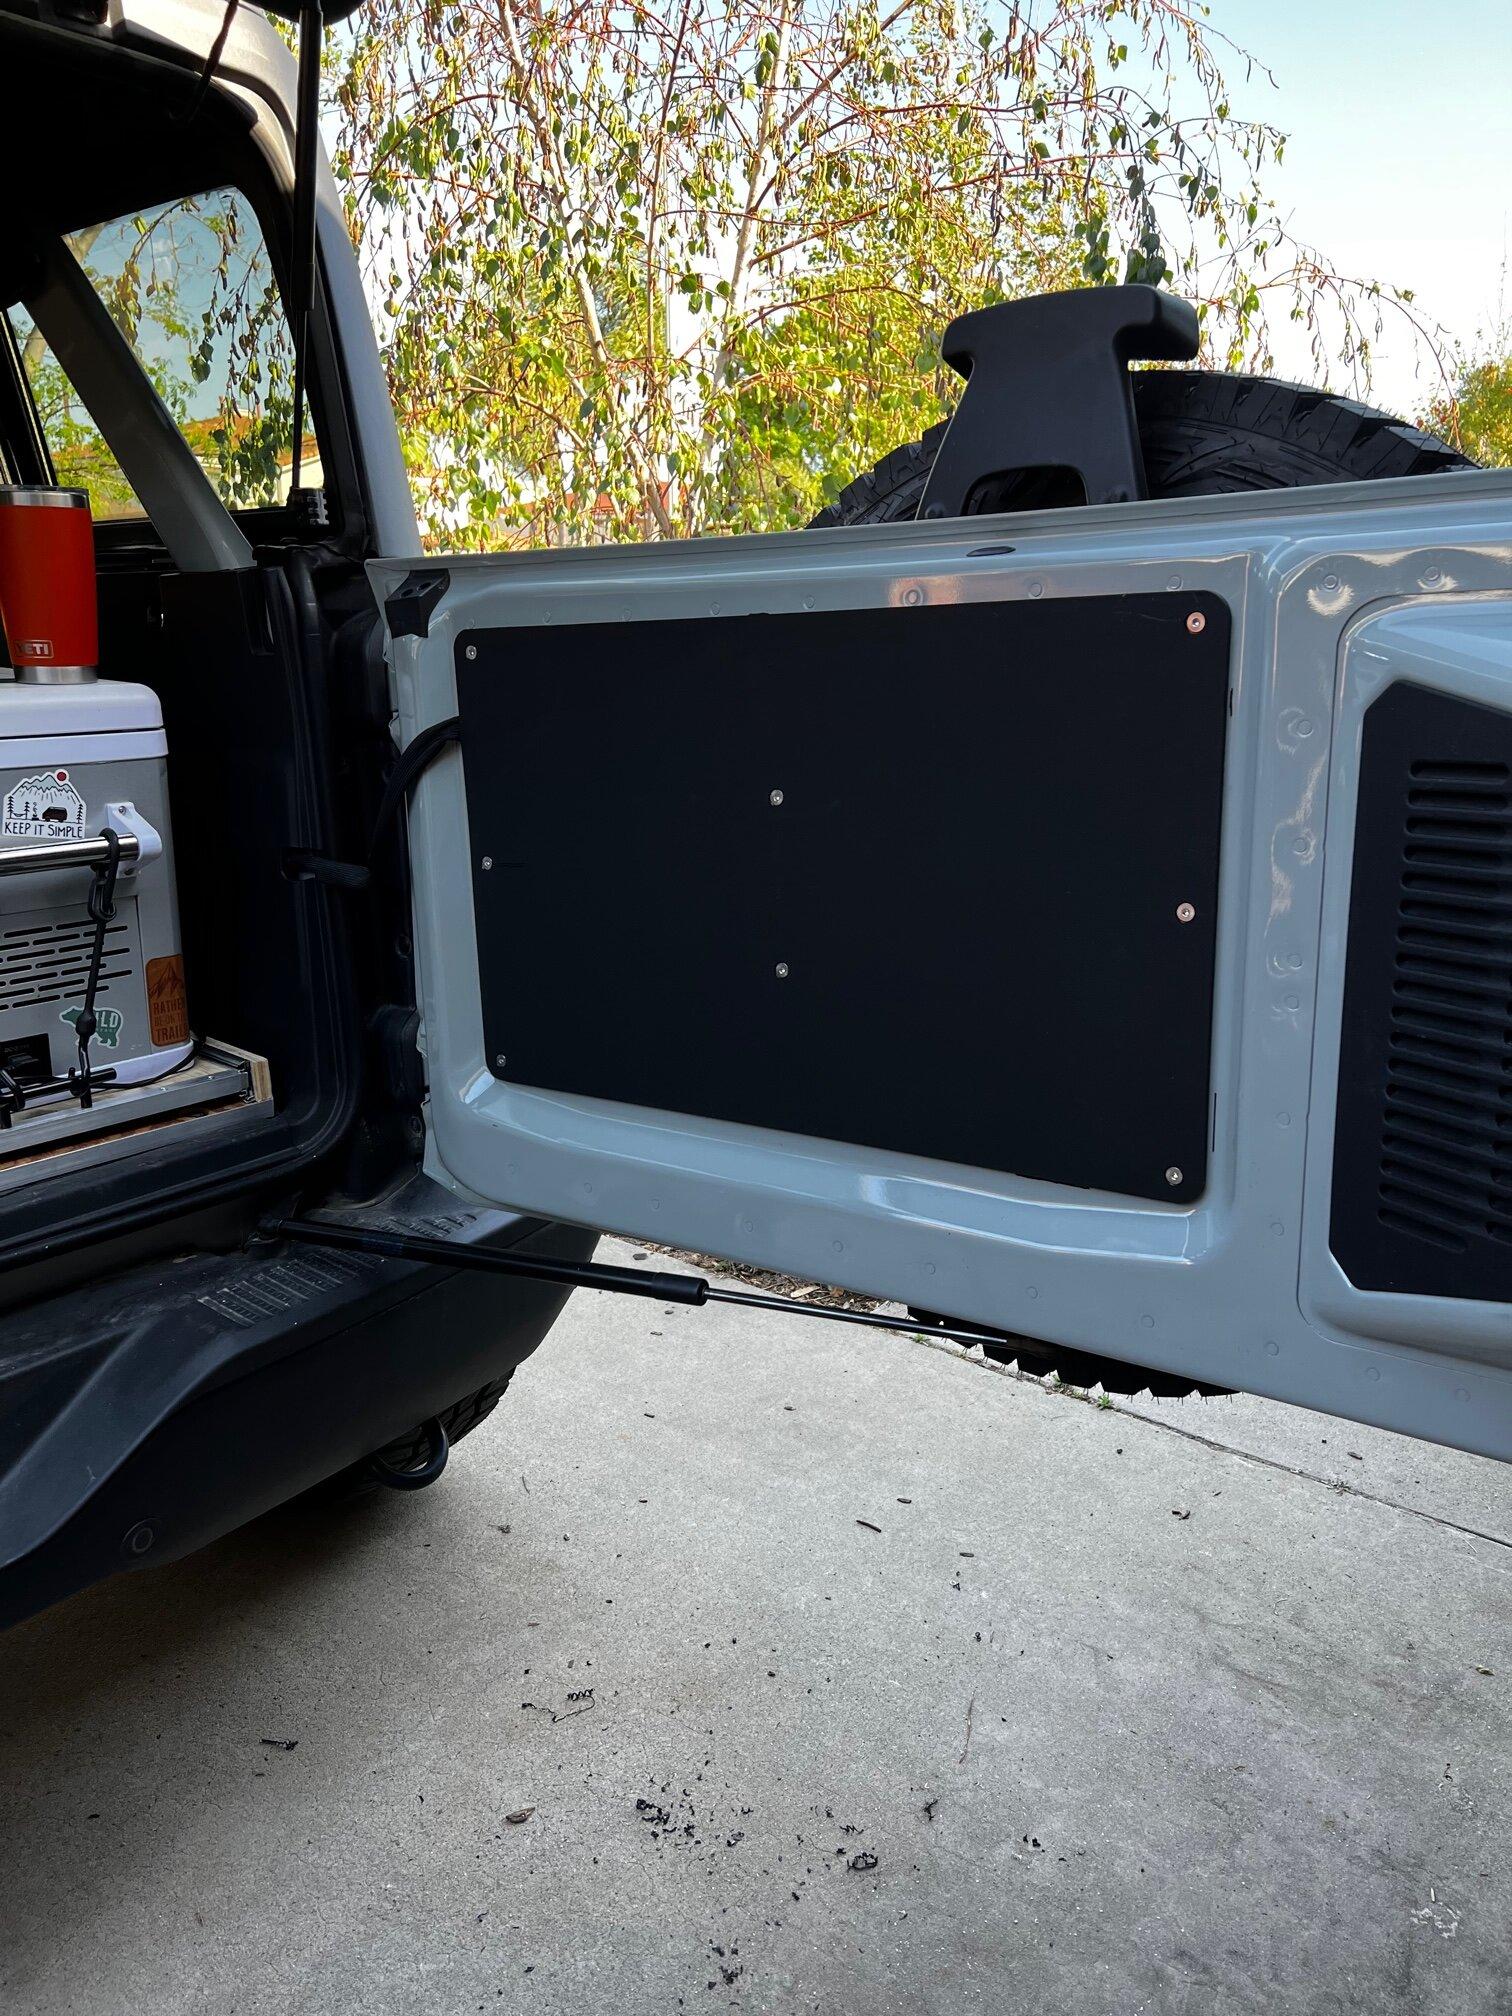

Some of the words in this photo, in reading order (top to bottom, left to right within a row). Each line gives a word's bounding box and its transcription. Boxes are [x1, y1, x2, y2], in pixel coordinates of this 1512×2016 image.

[15, 643, 49, 655] YETI
[4, 822, 31, 835] KEEP
[34, 824, 44, 836] IT
[48, 825, 83, 838] SIMPLE
[95, 1011, 119, 1028] ILD
